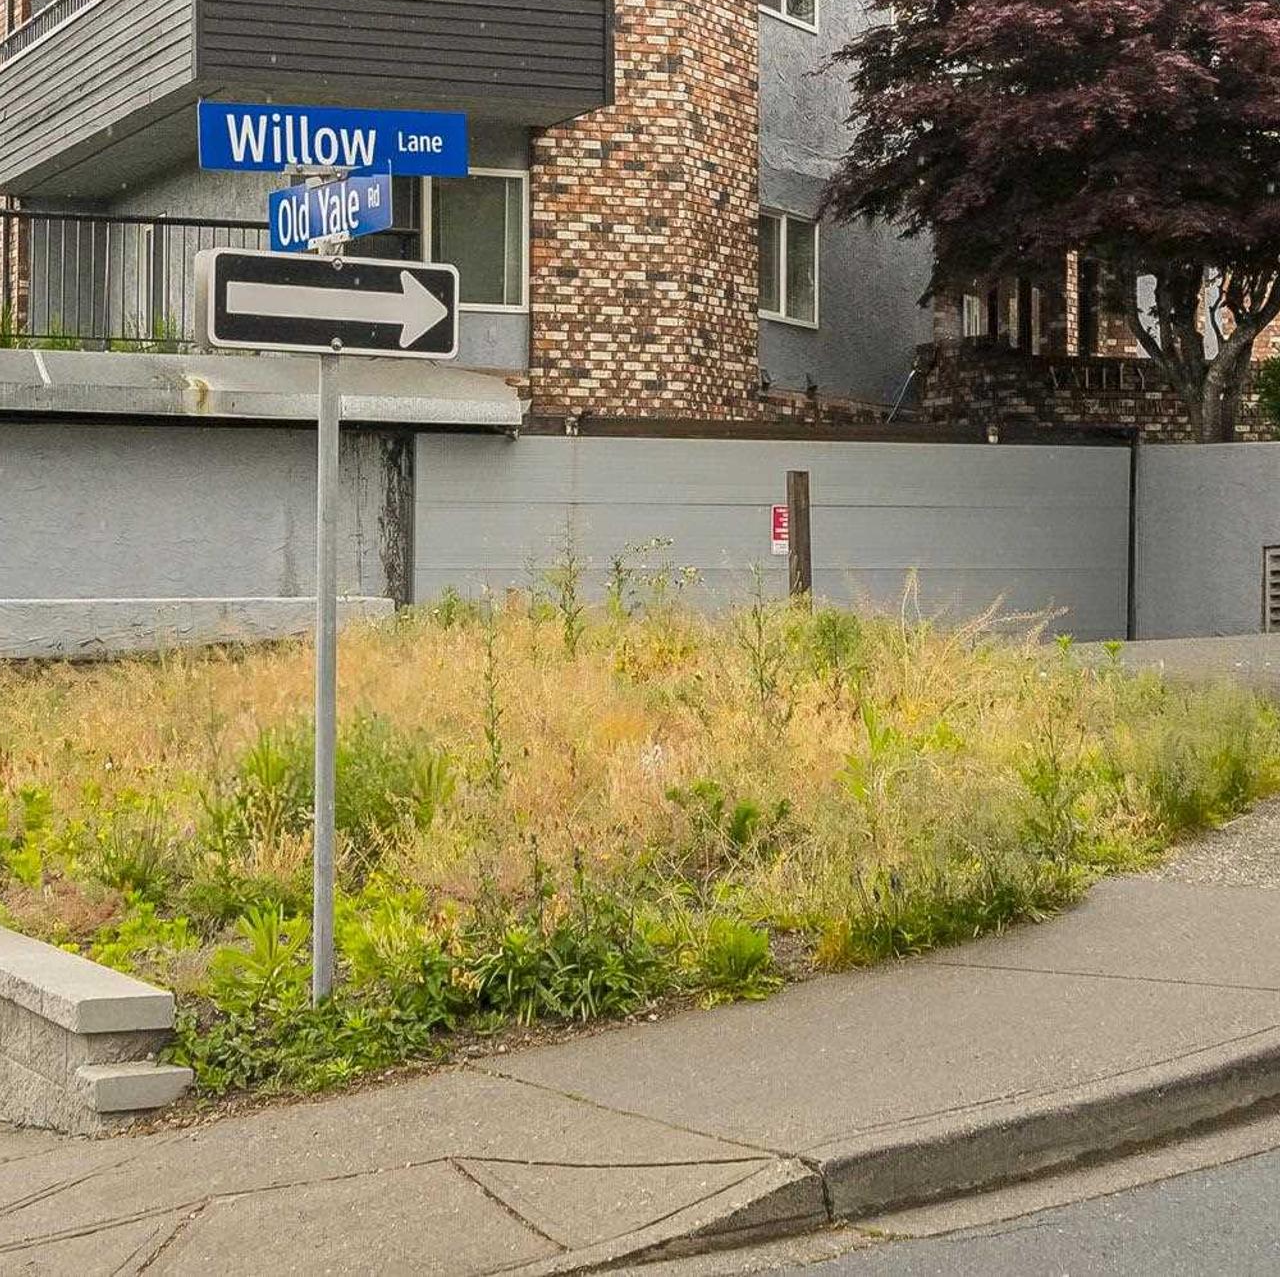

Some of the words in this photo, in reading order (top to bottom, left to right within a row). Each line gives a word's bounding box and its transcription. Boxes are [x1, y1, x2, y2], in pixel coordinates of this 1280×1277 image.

[226, 113, 377, 166] Willow
[398, 131, 443, 153] Lane
[278, 194, 310, 246] Old
[318, 184, 360, 235] Yale
[367, 184, 380, 208] Rd
